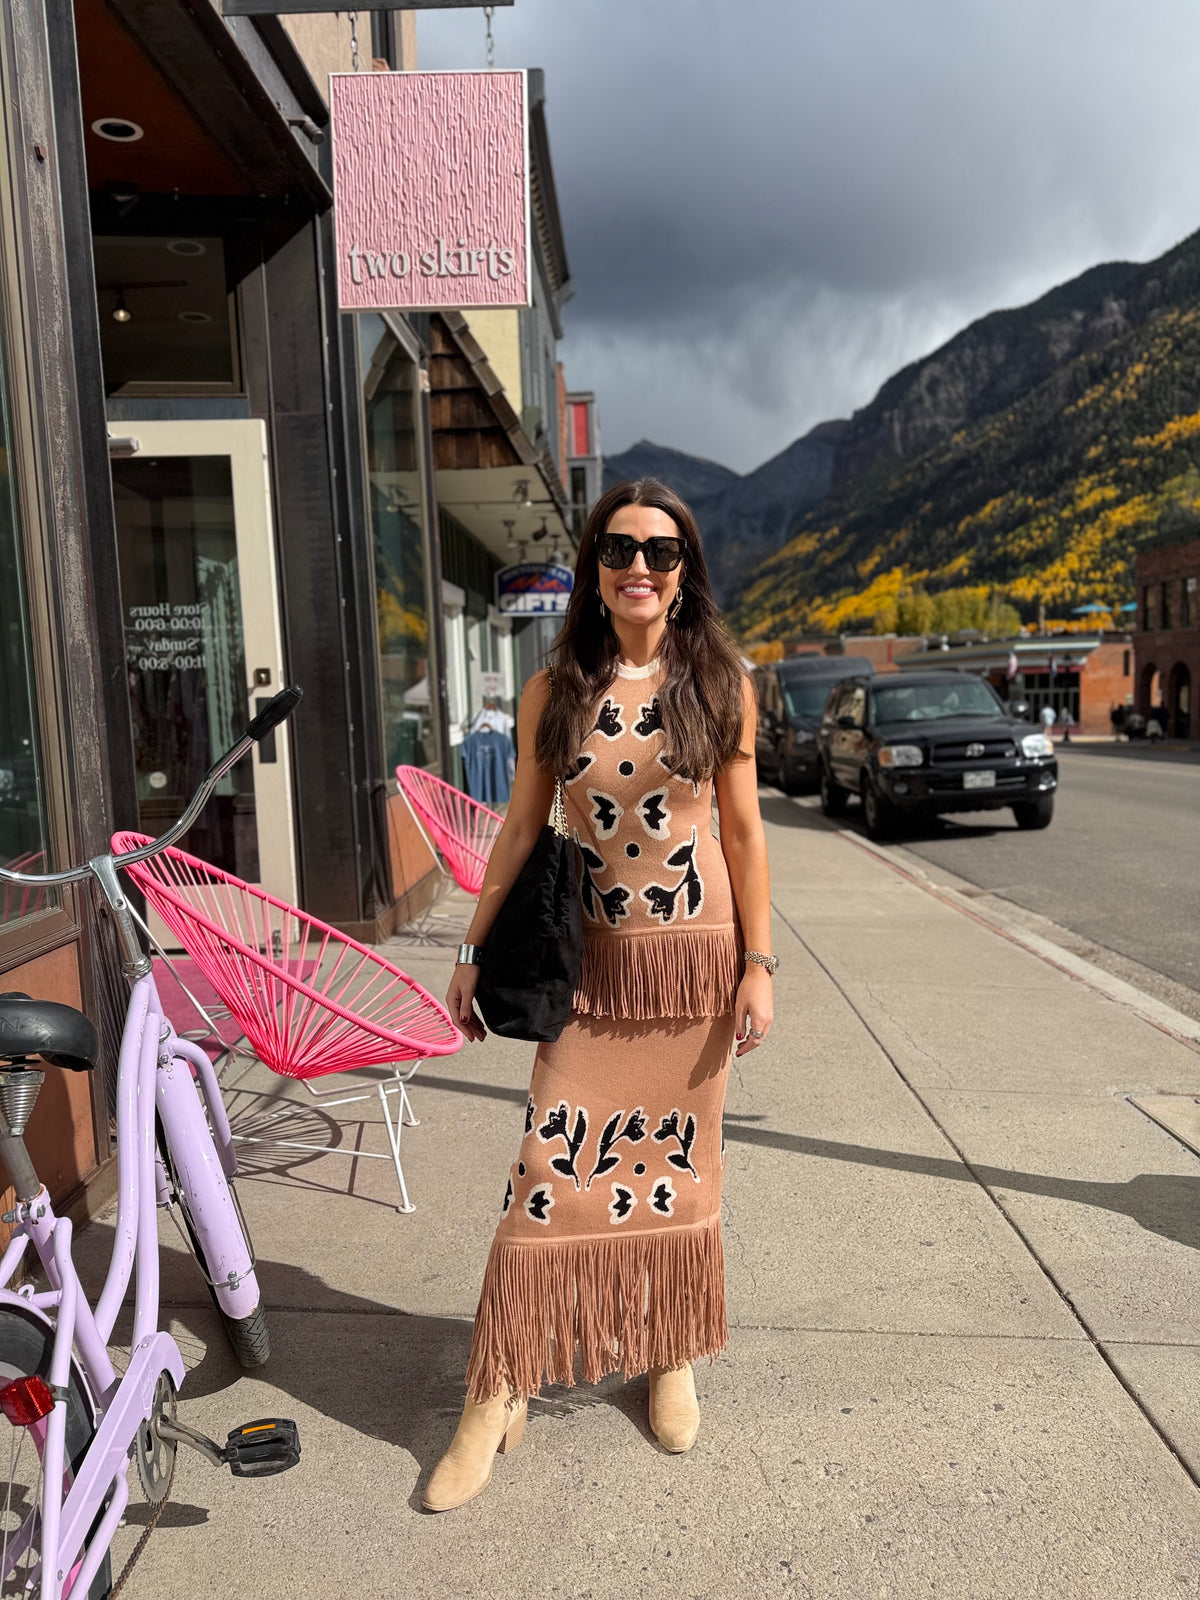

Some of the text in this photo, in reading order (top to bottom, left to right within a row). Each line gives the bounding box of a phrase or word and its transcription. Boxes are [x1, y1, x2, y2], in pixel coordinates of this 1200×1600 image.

[350, 239, 514, 283] two skirts
[500, 592, 571, 611] GIFTS
